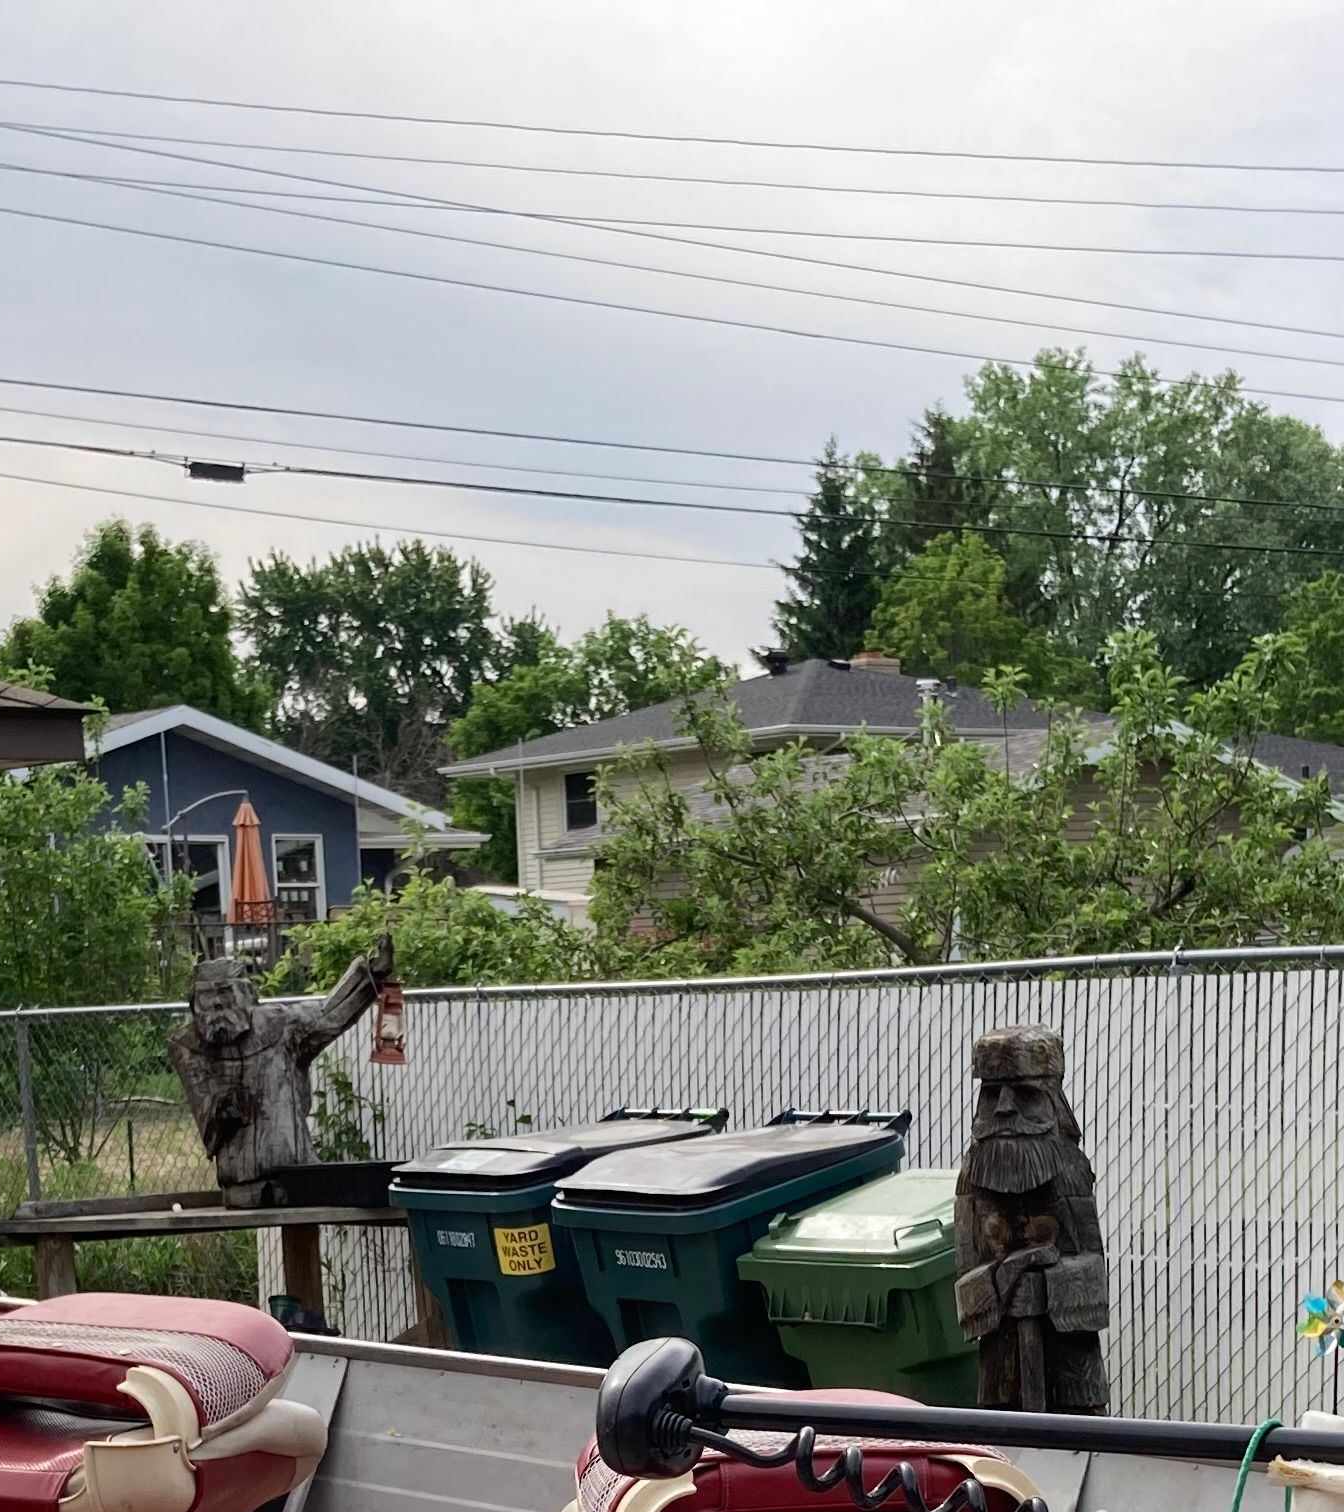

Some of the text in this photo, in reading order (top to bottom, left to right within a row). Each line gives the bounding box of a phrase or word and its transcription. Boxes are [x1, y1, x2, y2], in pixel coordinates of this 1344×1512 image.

[502, 1229, 539, 1244] YARD
[501, 1241, 548, 1257] WASTE
[509, 1257, 543, 1272] ONLY
